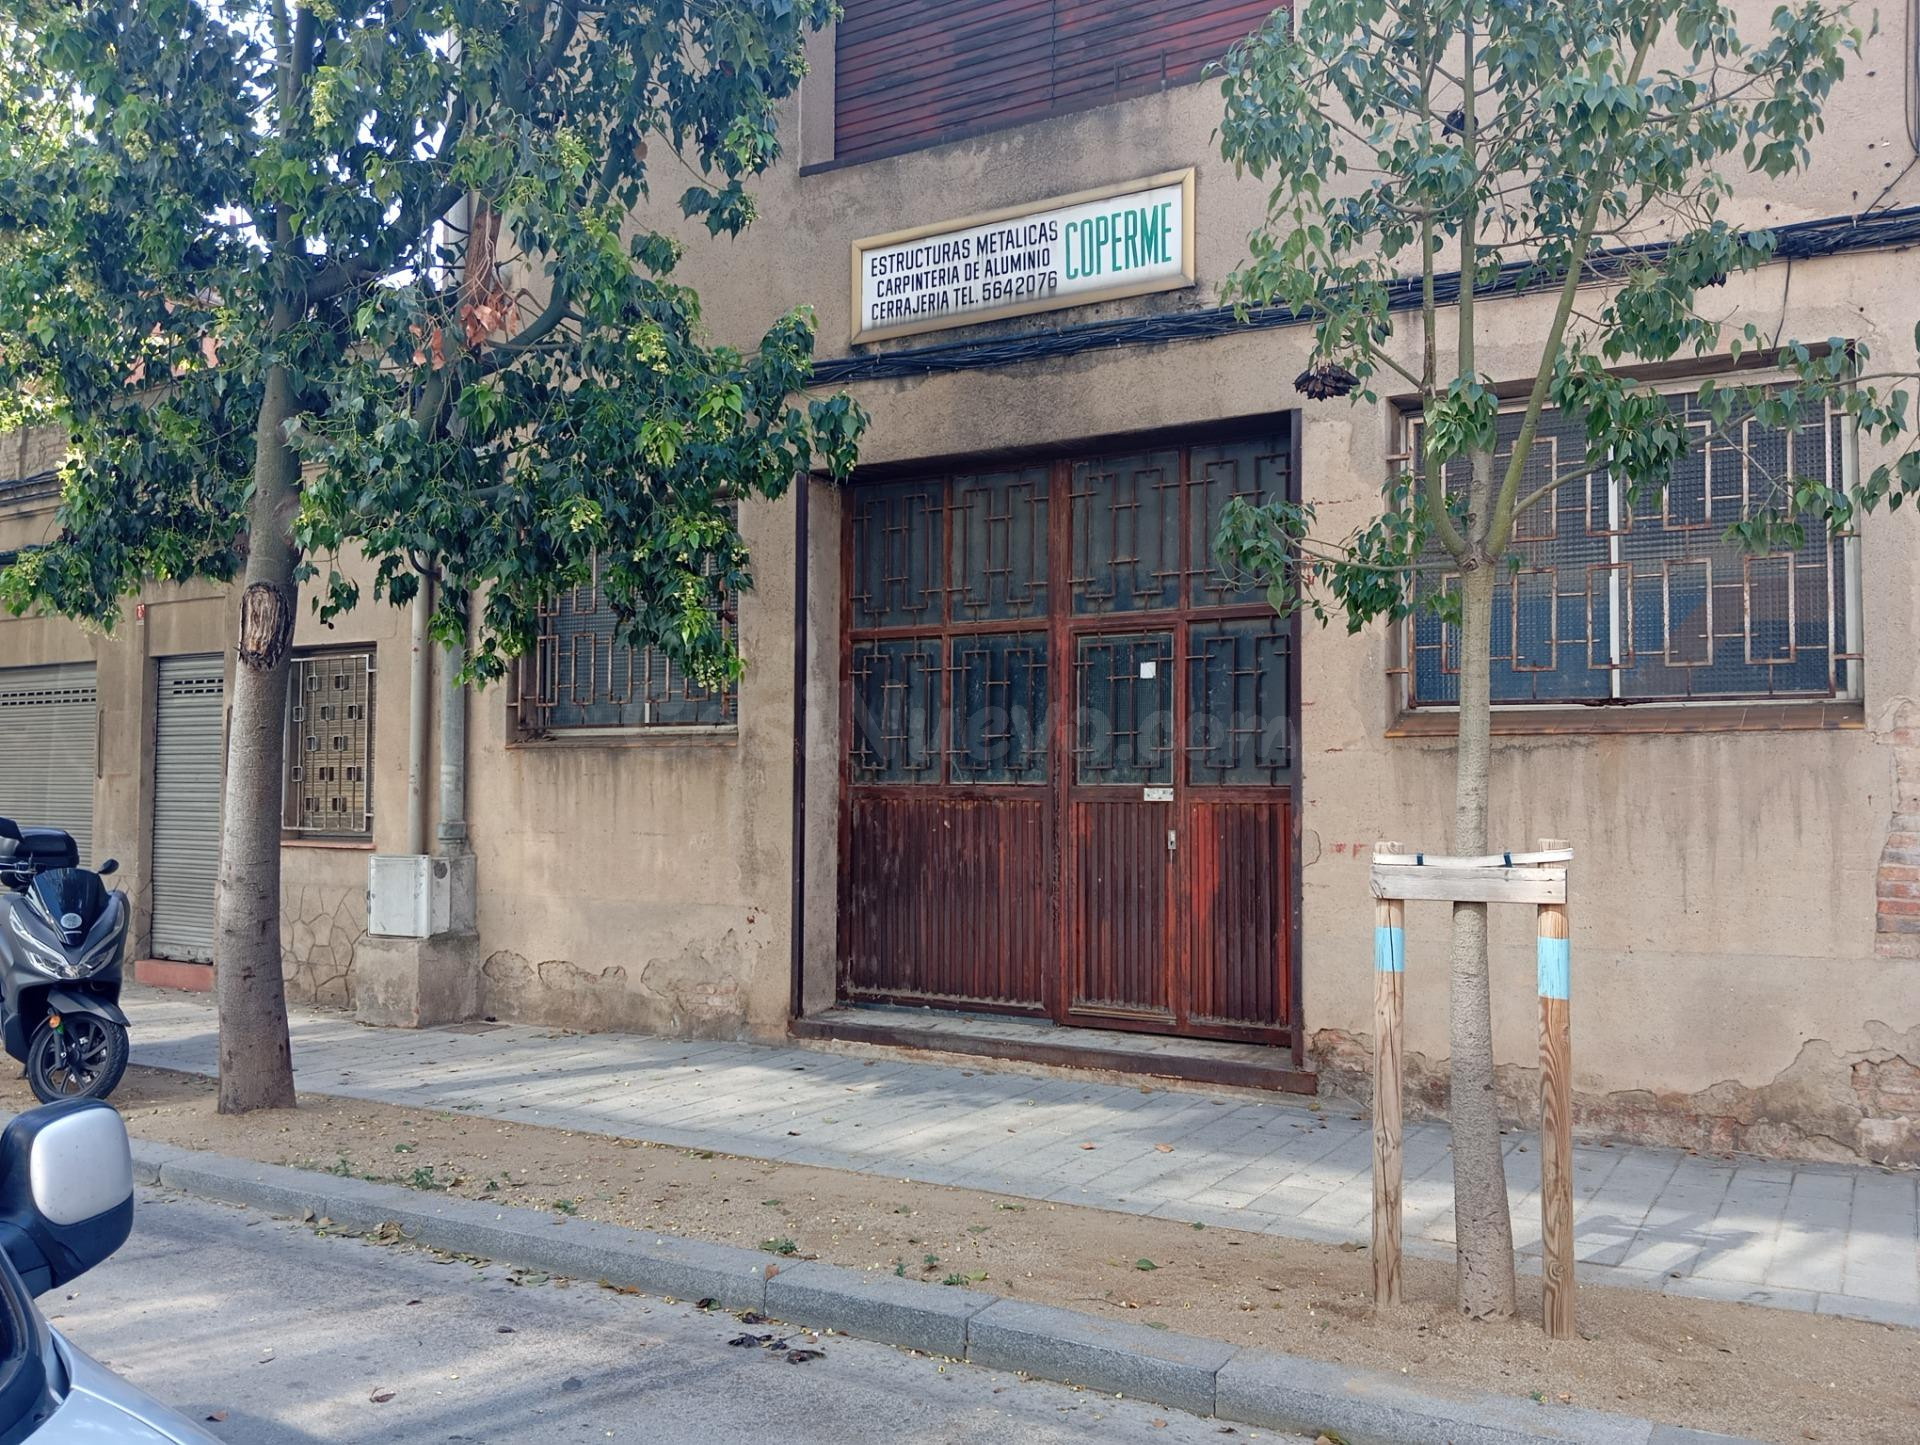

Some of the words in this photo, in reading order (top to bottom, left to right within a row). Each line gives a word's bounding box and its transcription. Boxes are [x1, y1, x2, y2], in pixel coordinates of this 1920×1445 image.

[871, 238, 970, 277] ESTRUCTURAS
[976, 220, 1058, 257] METALICAS
[1065, 202, 1172, 280] COPERME
[871, 290, 949, 320] CERRAJERIA
[953, 285, 979, 307] TEL.
[982, 270, 1058, 301] 5642076
[877, 266, 960, 298] CARPINTERIA
[964, 262, 980, 282] DE
[984, 248, 1050, 279] ALUMINIO
